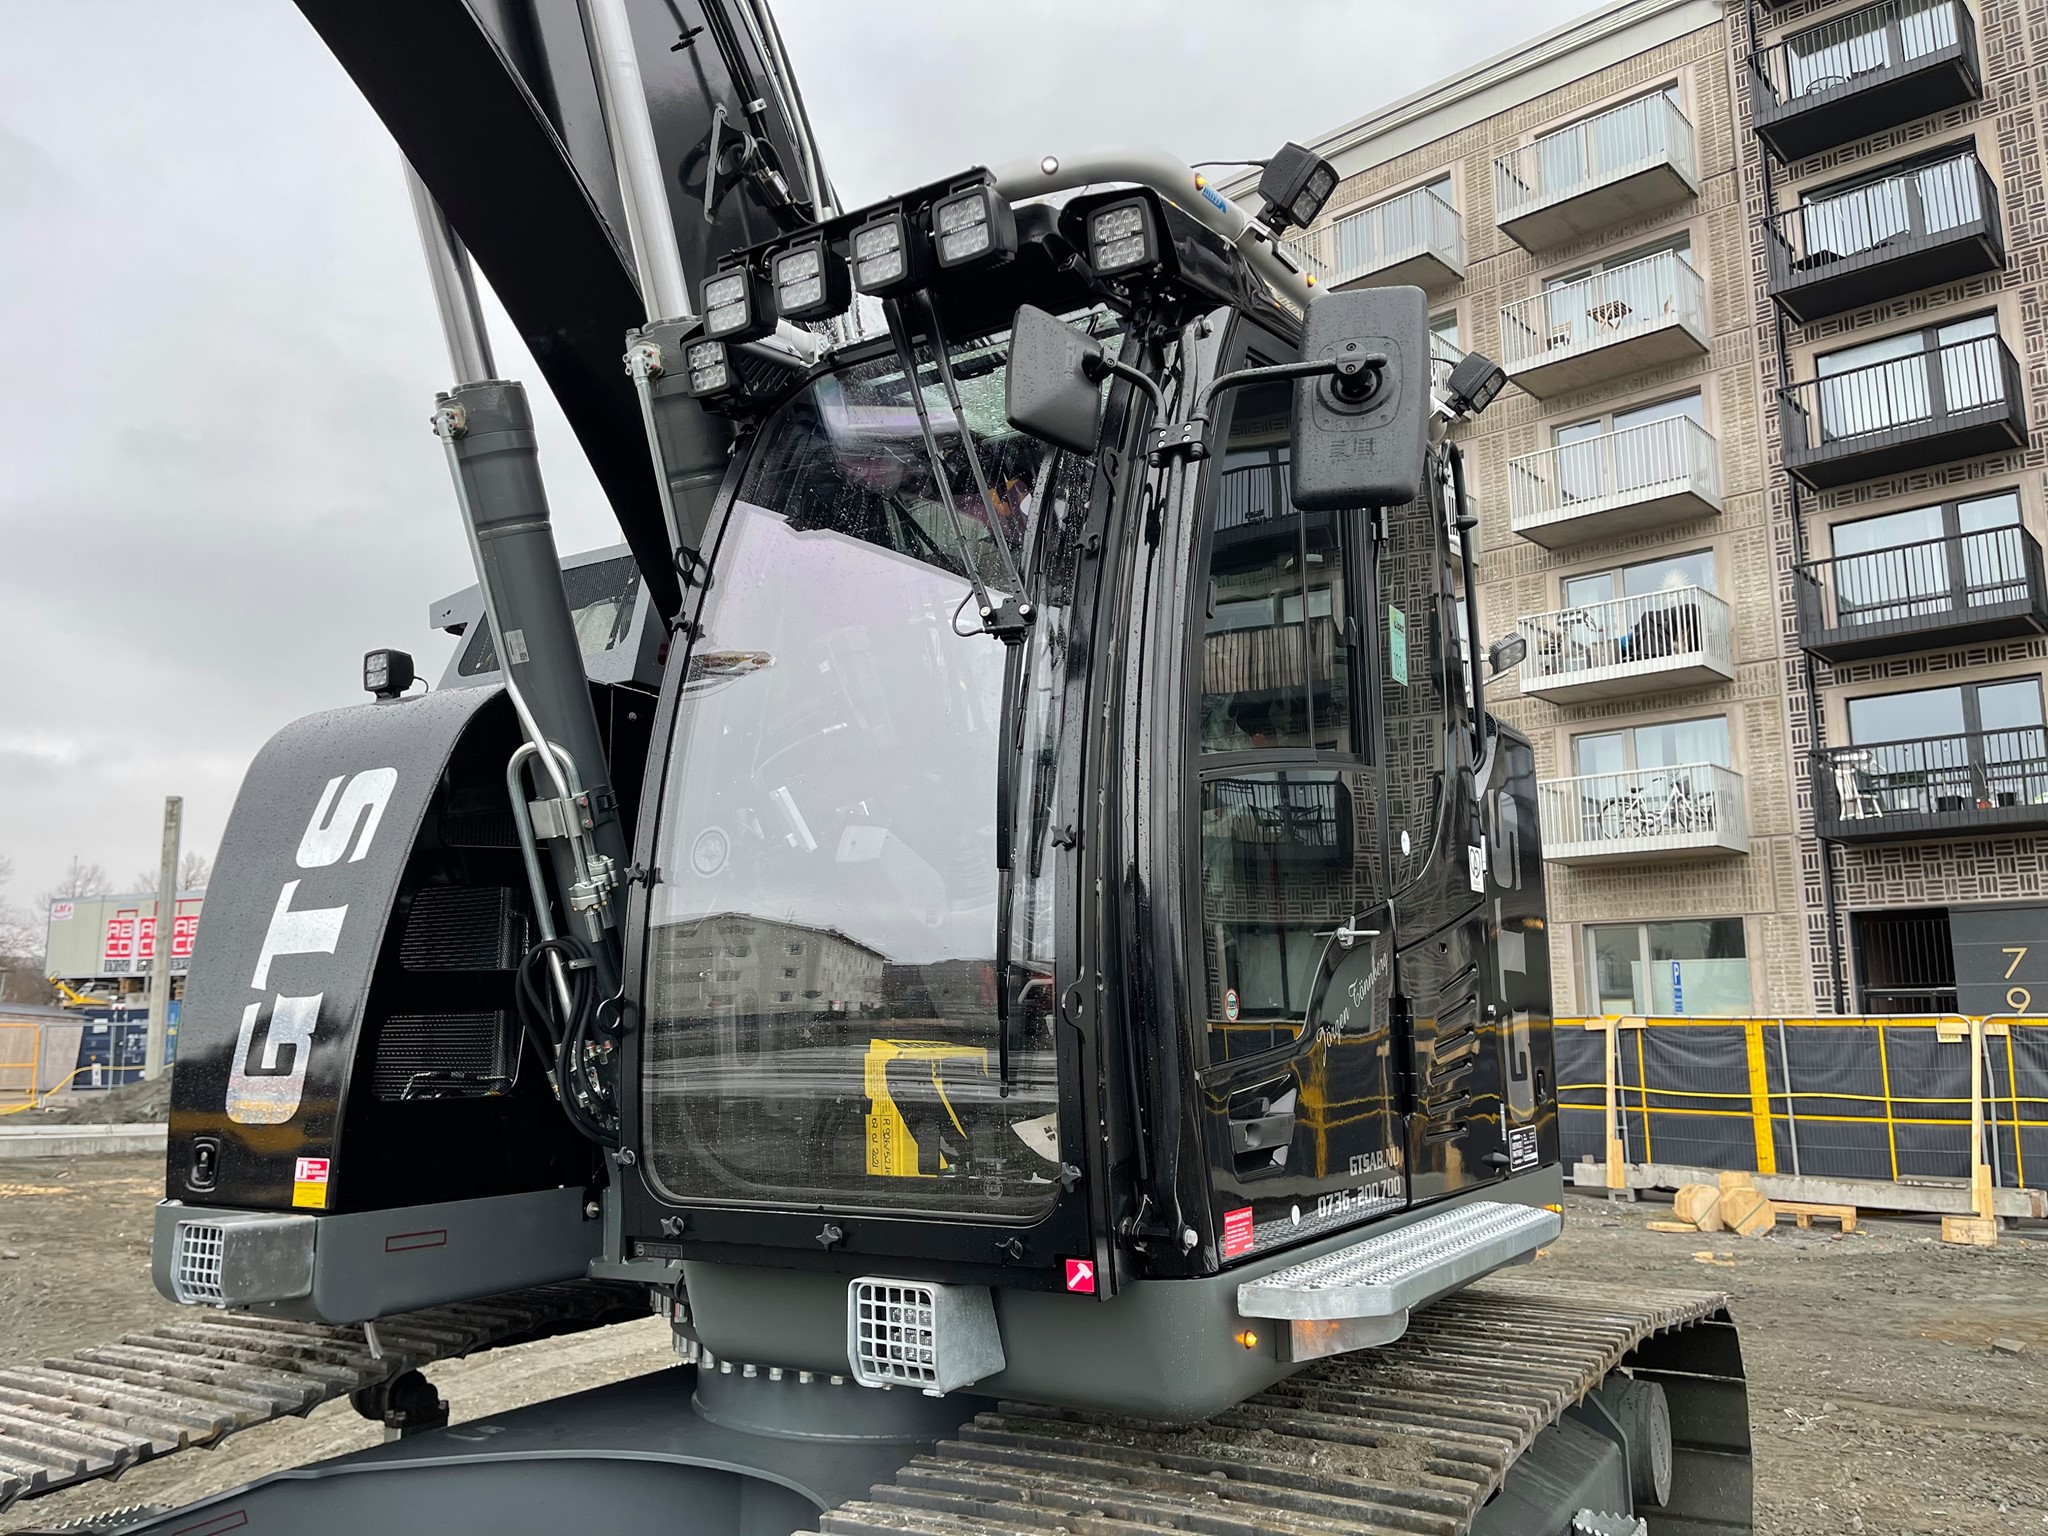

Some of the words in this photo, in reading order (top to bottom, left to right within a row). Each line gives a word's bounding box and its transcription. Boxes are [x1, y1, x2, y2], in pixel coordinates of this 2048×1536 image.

[225, 767, 398, 1124] GTS
[1487, 788, 1535, 1123] GTS
[1673, 963, 1679, 984] P
[2002, 947, 2028, 979] 7
[2006, 987, 2031, 1016] 9
[1349, 1146, 1400, 1177] GTSAB.NU
